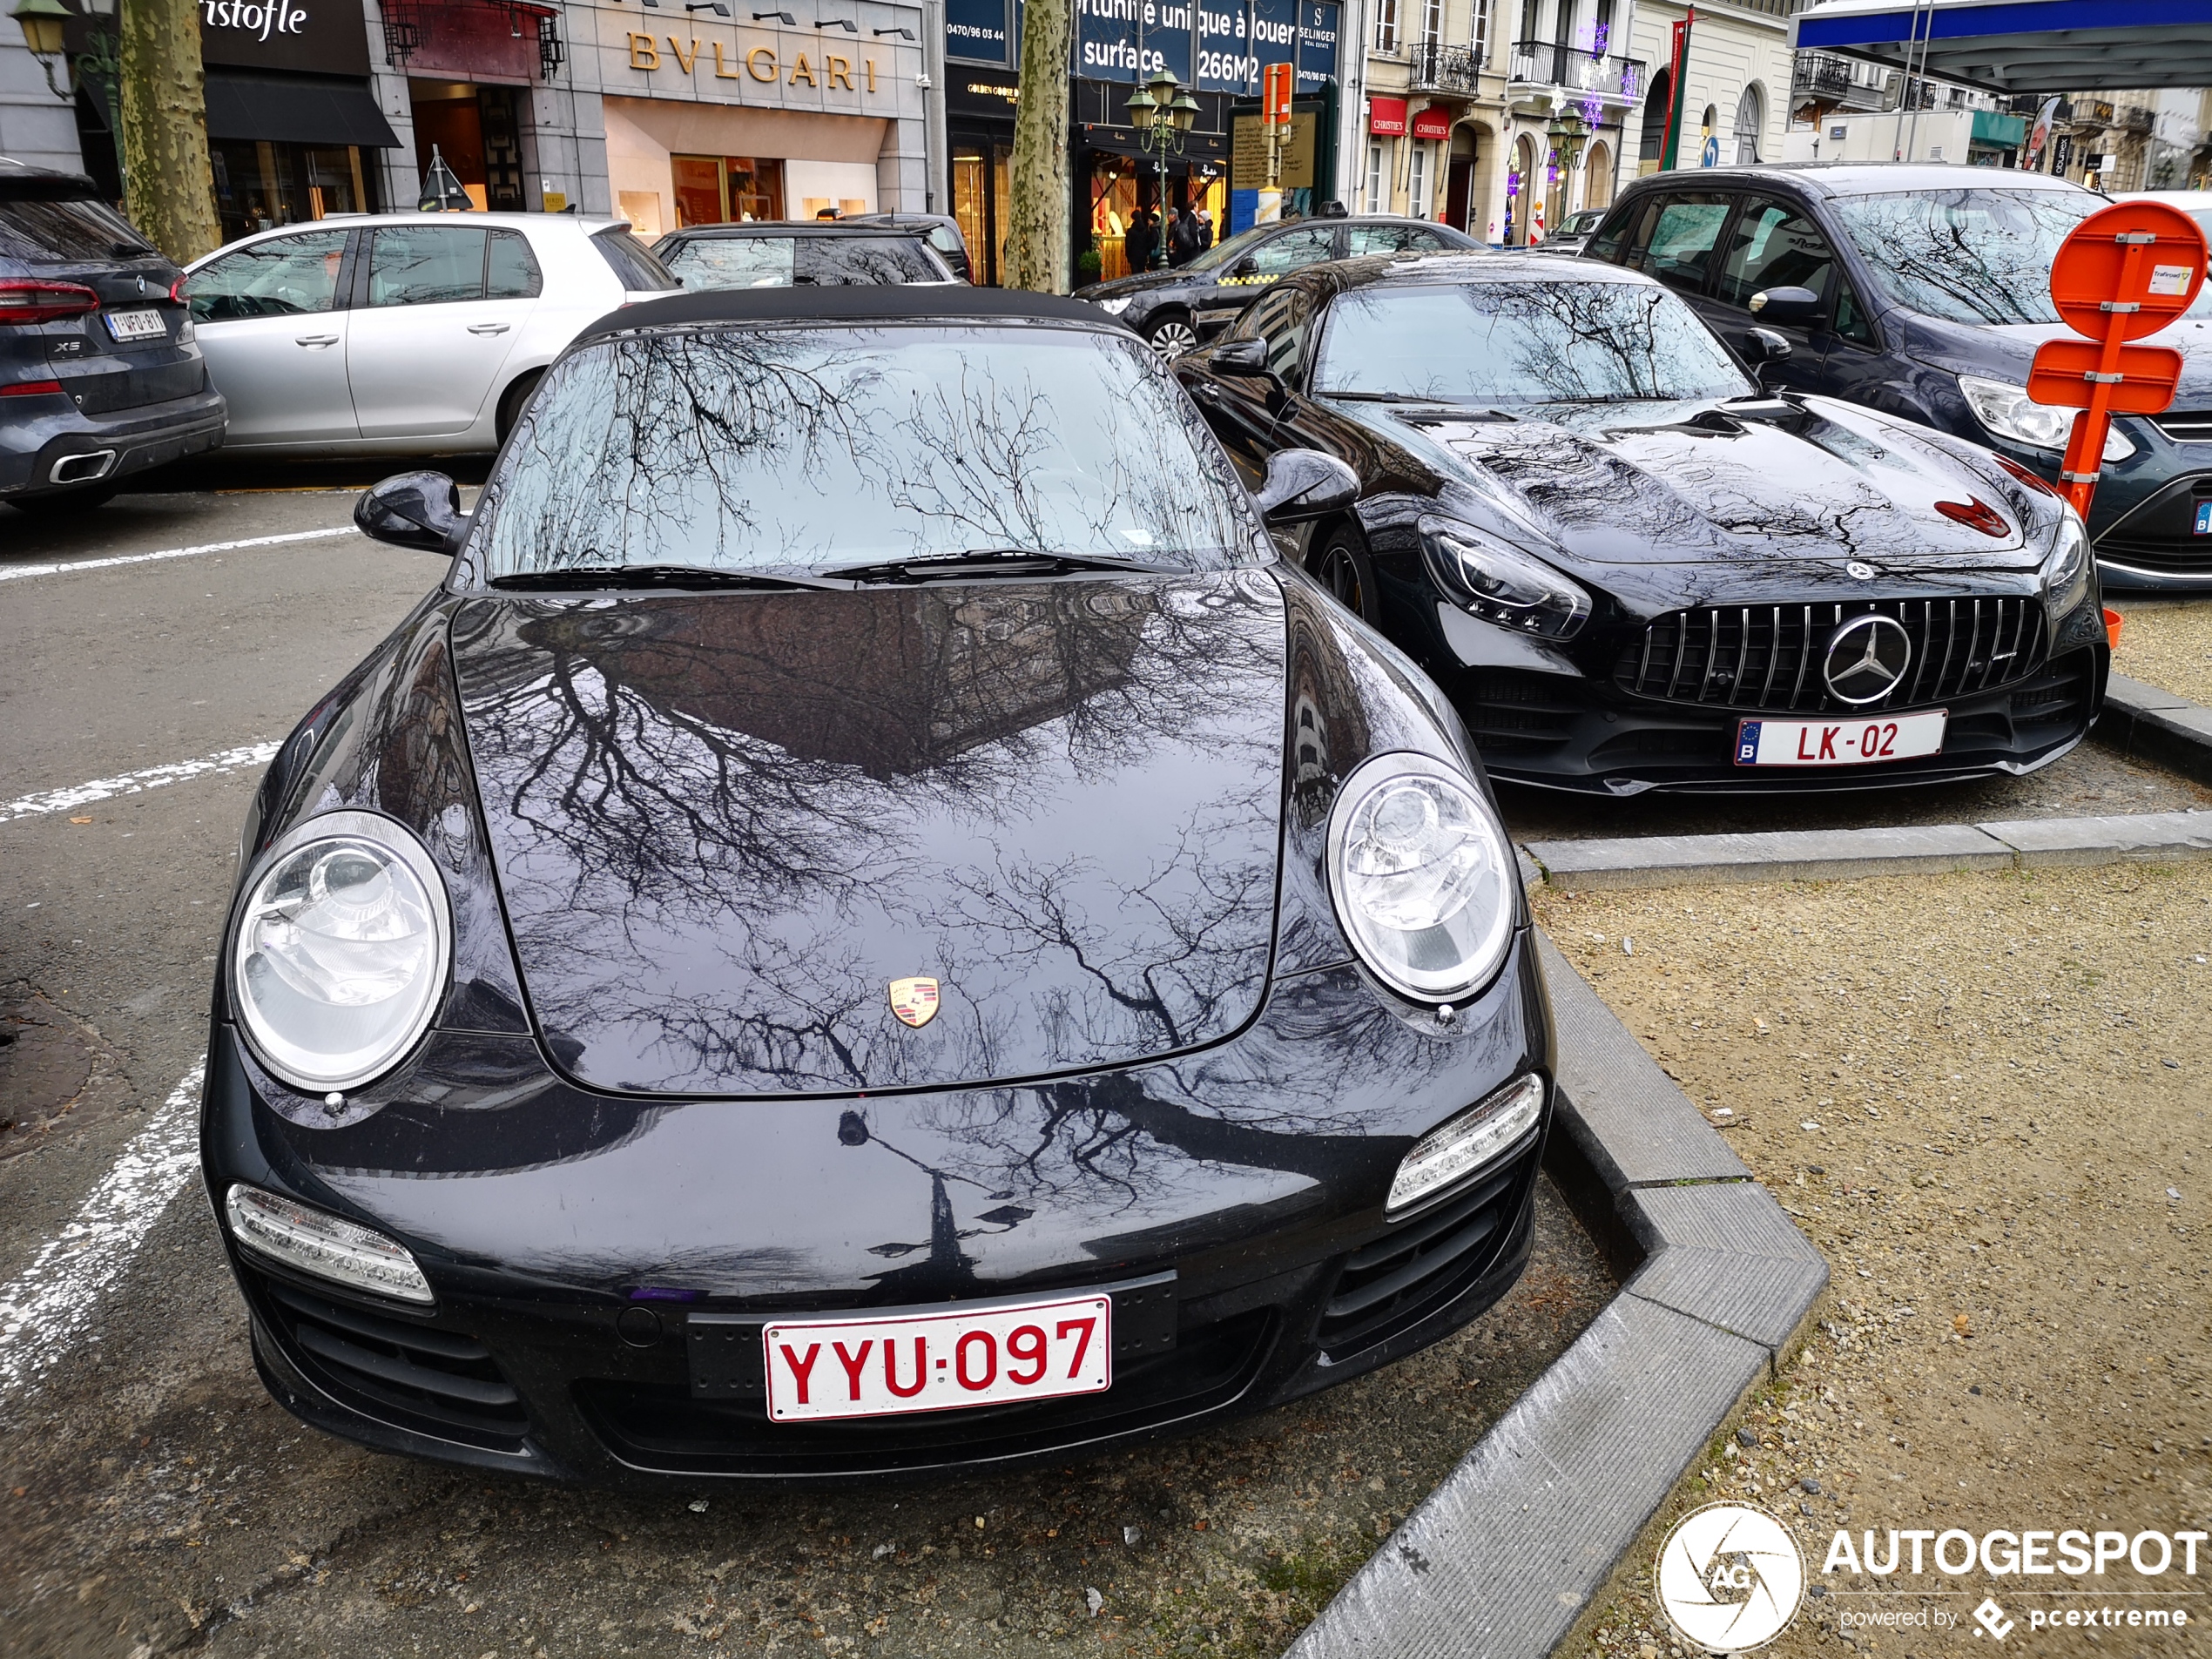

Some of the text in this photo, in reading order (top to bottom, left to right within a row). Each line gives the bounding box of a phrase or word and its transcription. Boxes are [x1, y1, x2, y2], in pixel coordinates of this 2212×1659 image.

[1162, 2, 1231, 37] unique
[1235, 10, 1246, 38] à
[1251, 12, 1295, 45] louer
[947, 24, 1004, 41] 0470/96 03 44
[1299, 26, 1336, 43] SELINGER
[627, 31, 876, 92] BVLGARI
[1084, 39, 1259, 84] surface 266M2
[1298, 70, 1319, 81] 0470/96
[1319, 73, 1326, 82] 03
[968, 84, 992, 94] GOLDEN
[2055, 138, 2068, 173] obumex
[54, 341, 80, 353] X5
[2197, 520, 2206, 530] B
[1741, 745, 1754, 759] B
